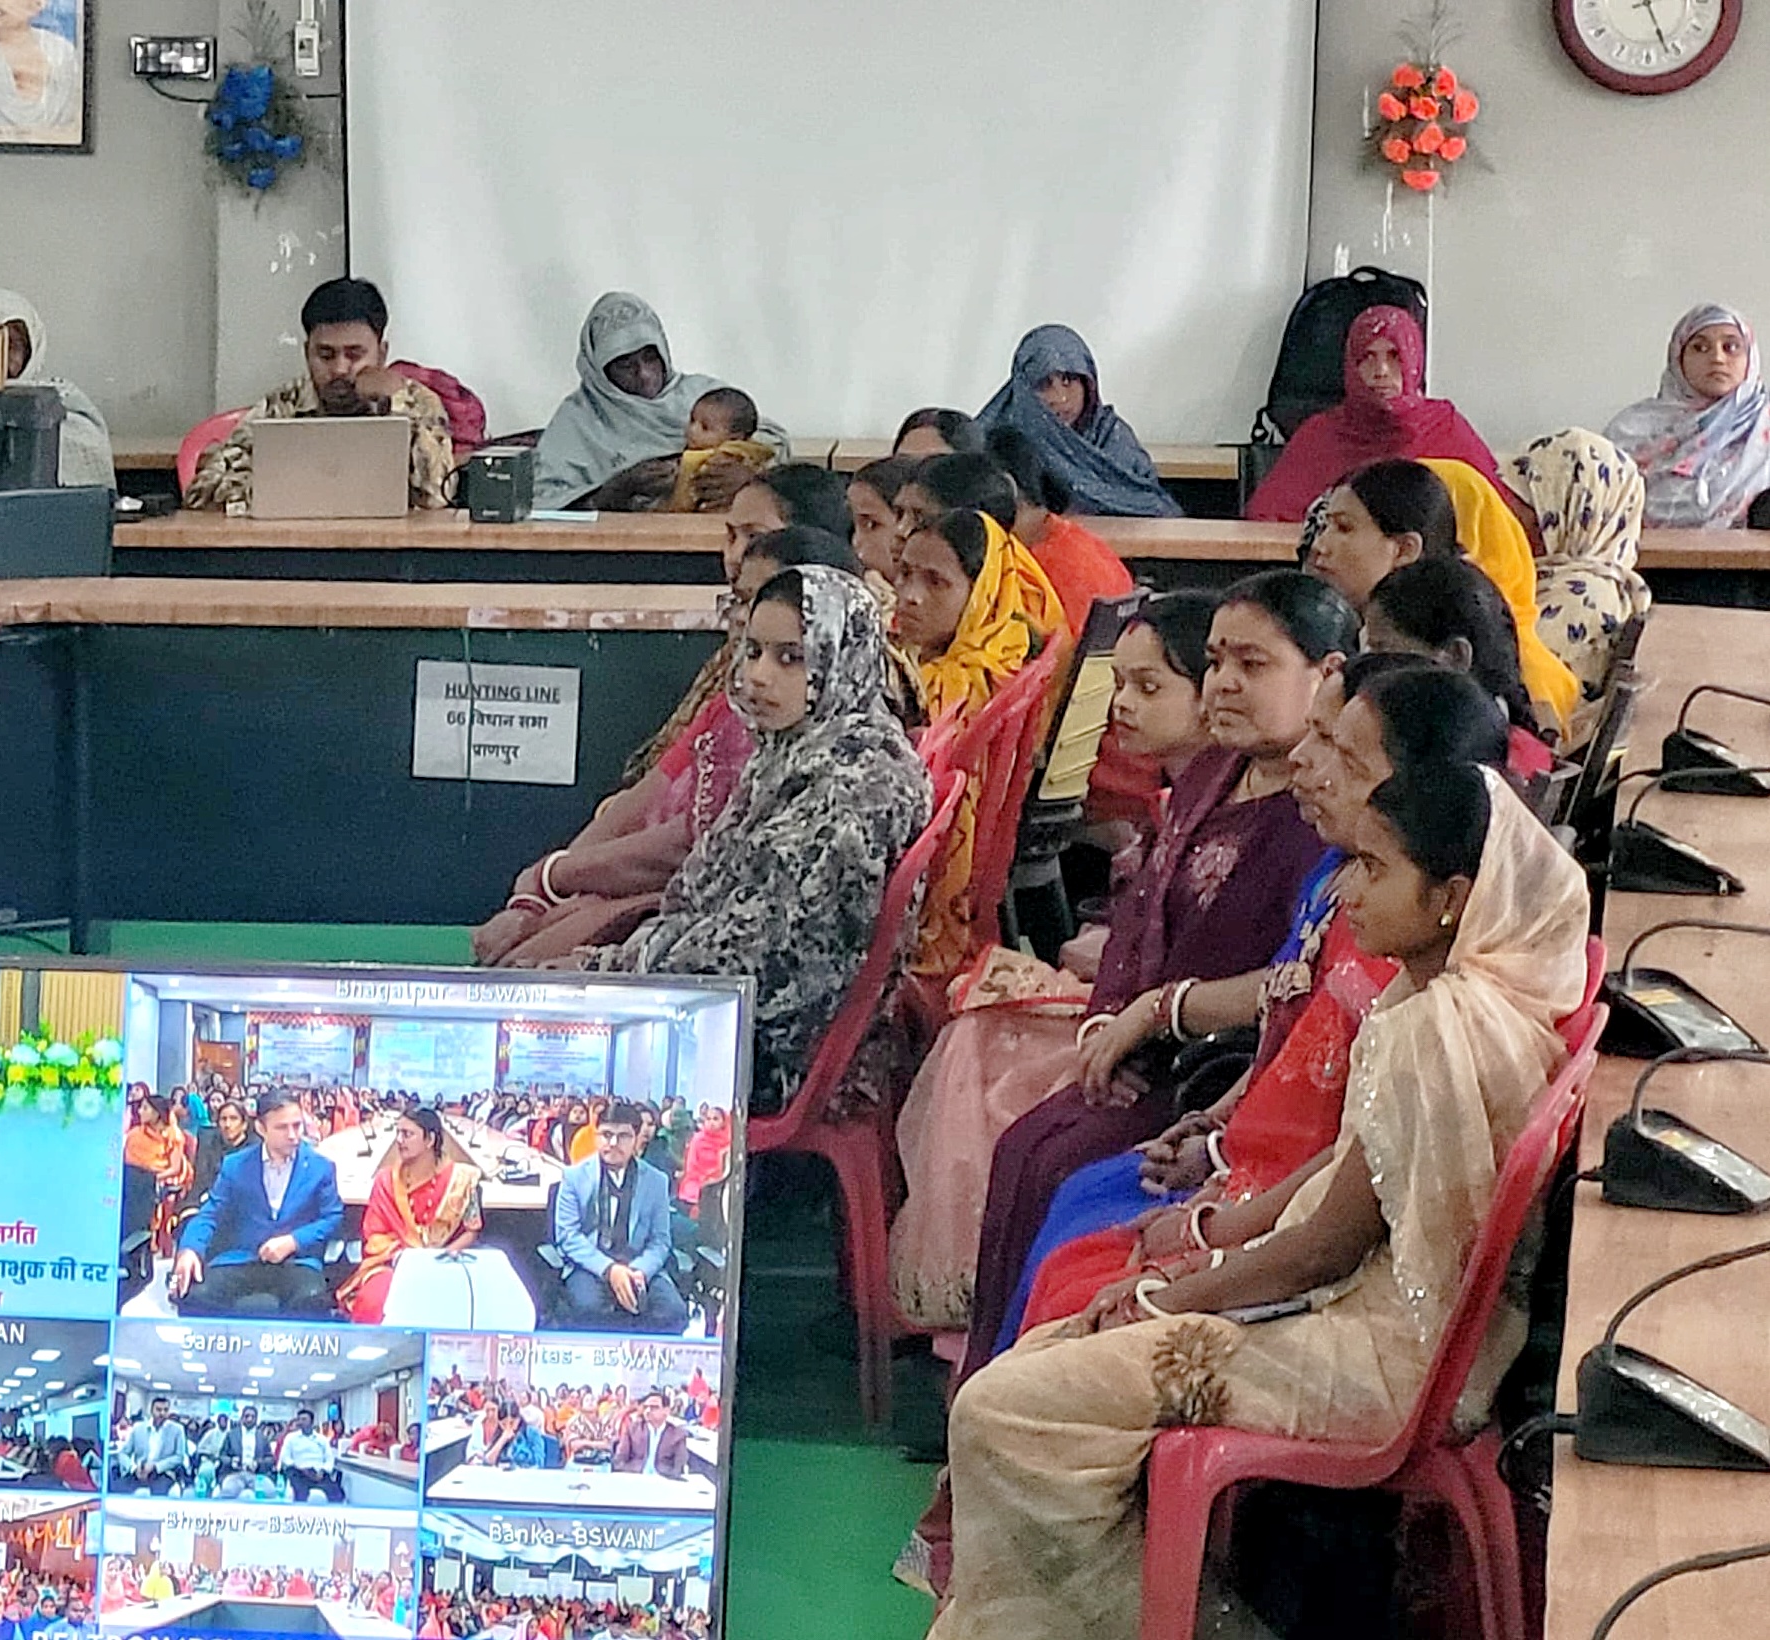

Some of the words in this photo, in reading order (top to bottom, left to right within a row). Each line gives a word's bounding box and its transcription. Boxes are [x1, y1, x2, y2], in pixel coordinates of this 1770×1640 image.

[444, 683, 521, 701] HUNTING
[526, 686, 561, 703] LINE
[446, 711, 466, 726] 66
[50, 1256, 78, 1281] की
[82, 1263, 108, 1283] दर
[488, 1522, 564, 1546] Banka-
[574, 1527, 655, 1550] BSWAN
